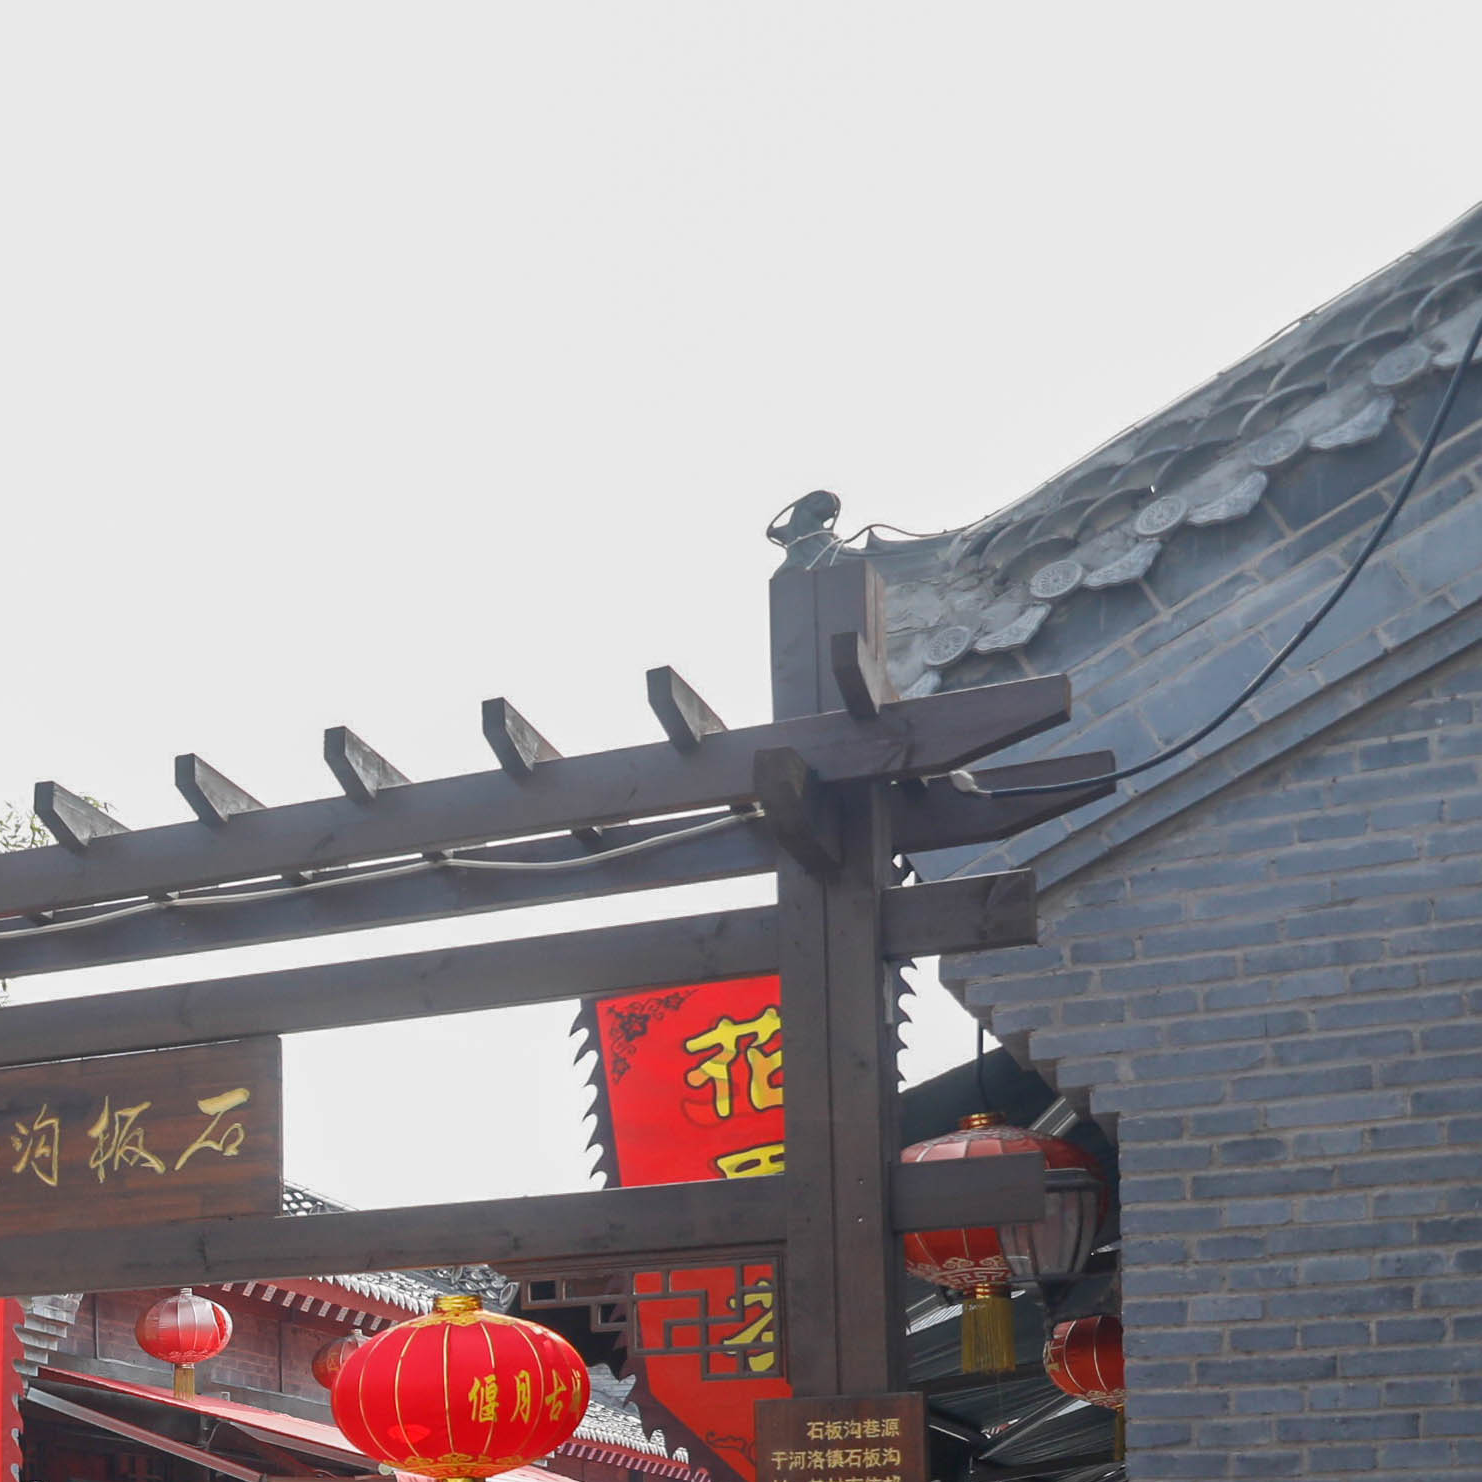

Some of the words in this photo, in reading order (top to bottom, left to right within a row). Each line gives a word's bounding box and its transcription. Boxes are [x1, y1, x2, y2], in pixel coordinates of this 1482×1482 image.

[807, 1418, 900, 1440] 石板沟巷源
[771, 1448, 901, 1470] 于河洛镇石板沟
